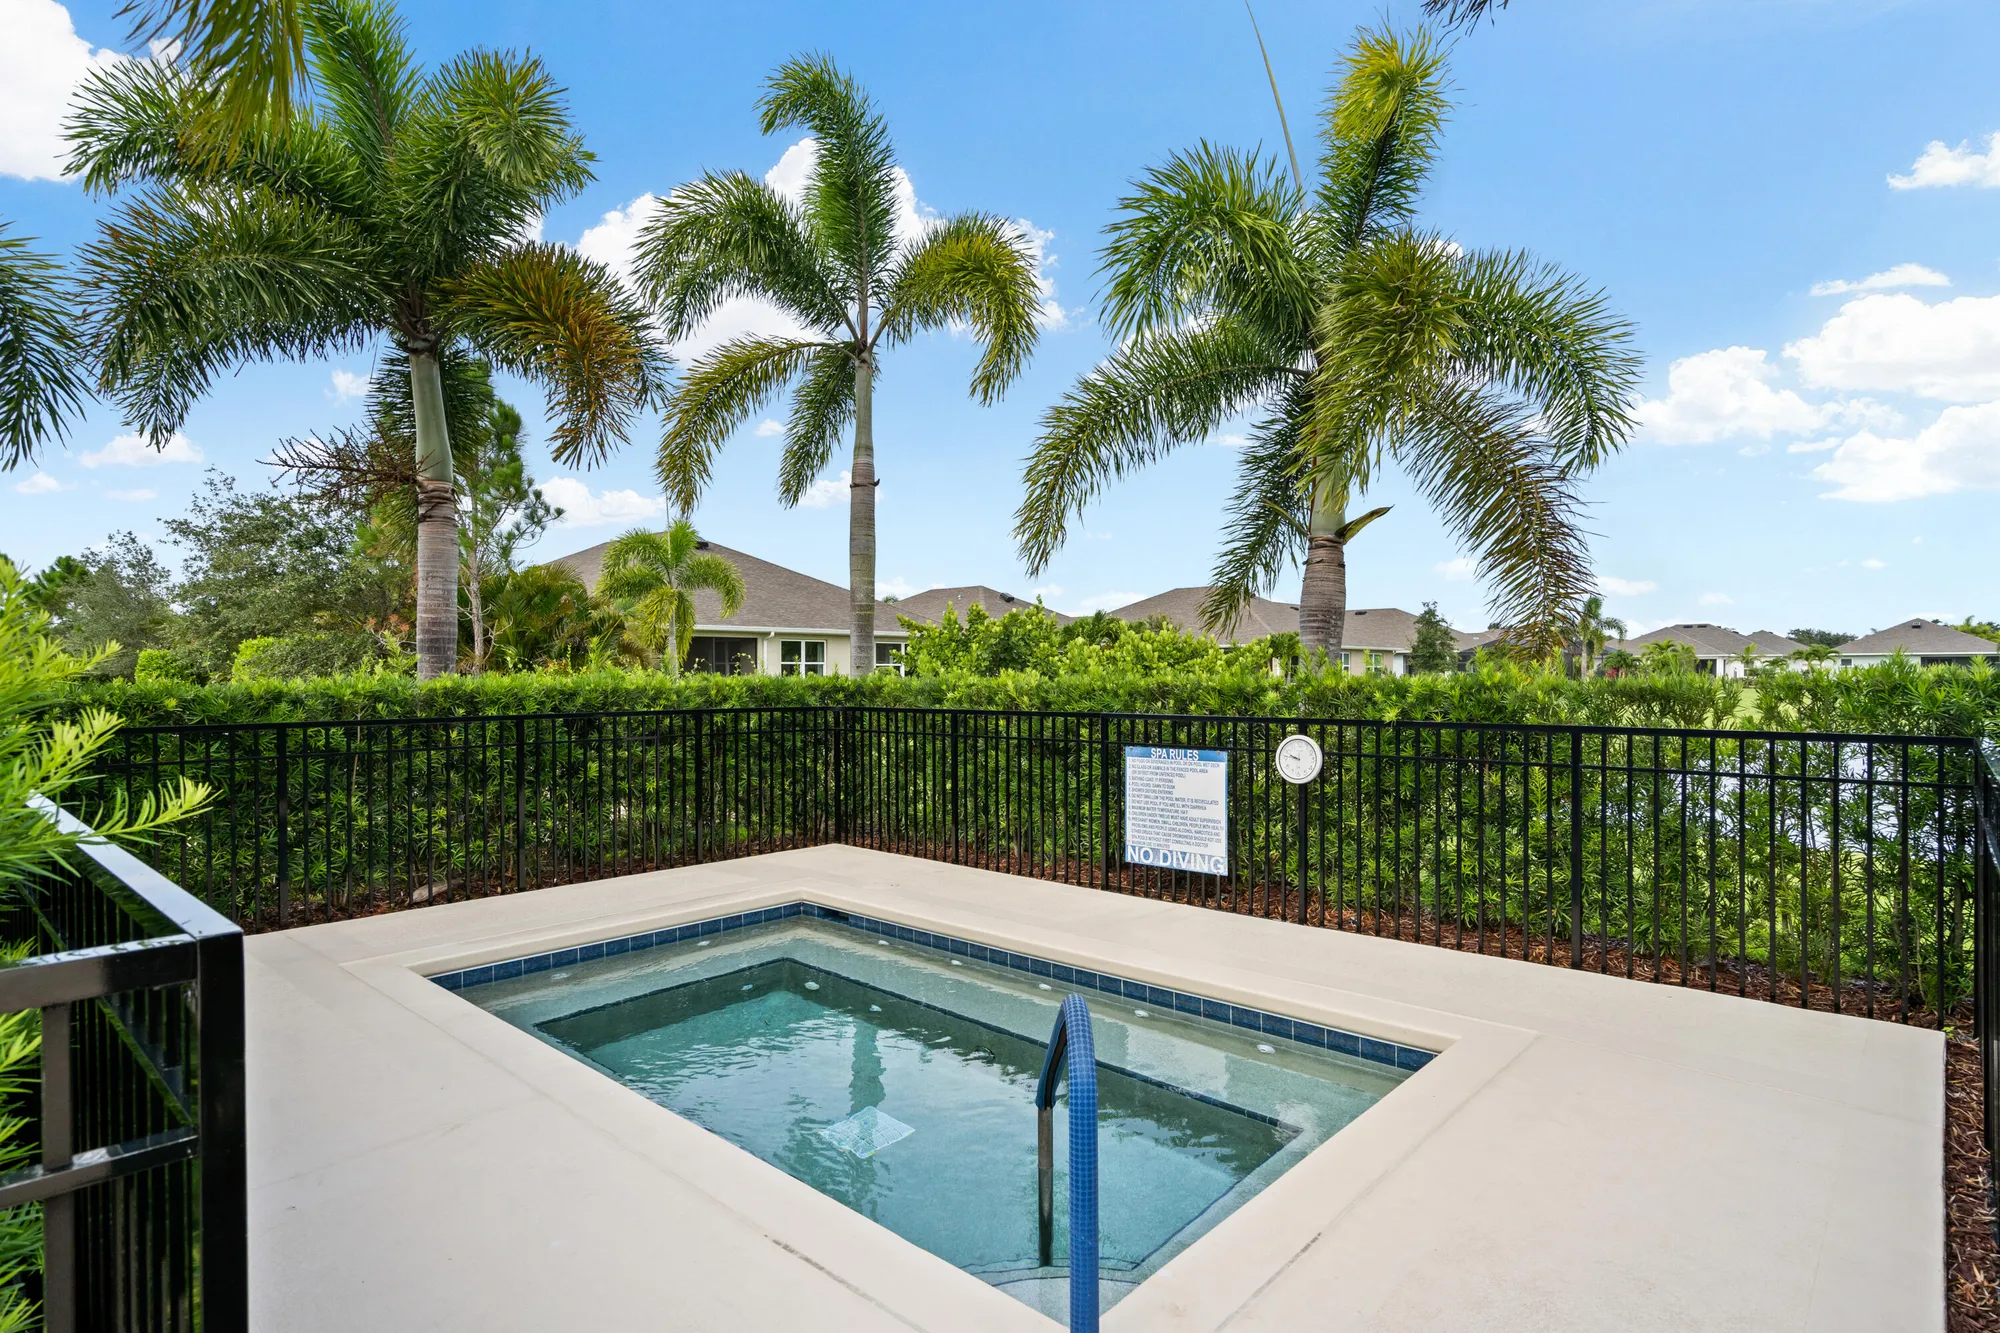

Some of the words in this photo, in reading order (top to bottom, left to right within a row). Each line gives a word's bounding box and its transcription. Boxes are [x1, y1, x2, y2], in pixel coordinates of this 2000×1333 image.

[1150, 748, 1168, 759] SPA
[1170, 749, 1198, 760] RULES
[1128, 846, 1153, 863] NO
[1160, 850, 1224, 874] DIVING
